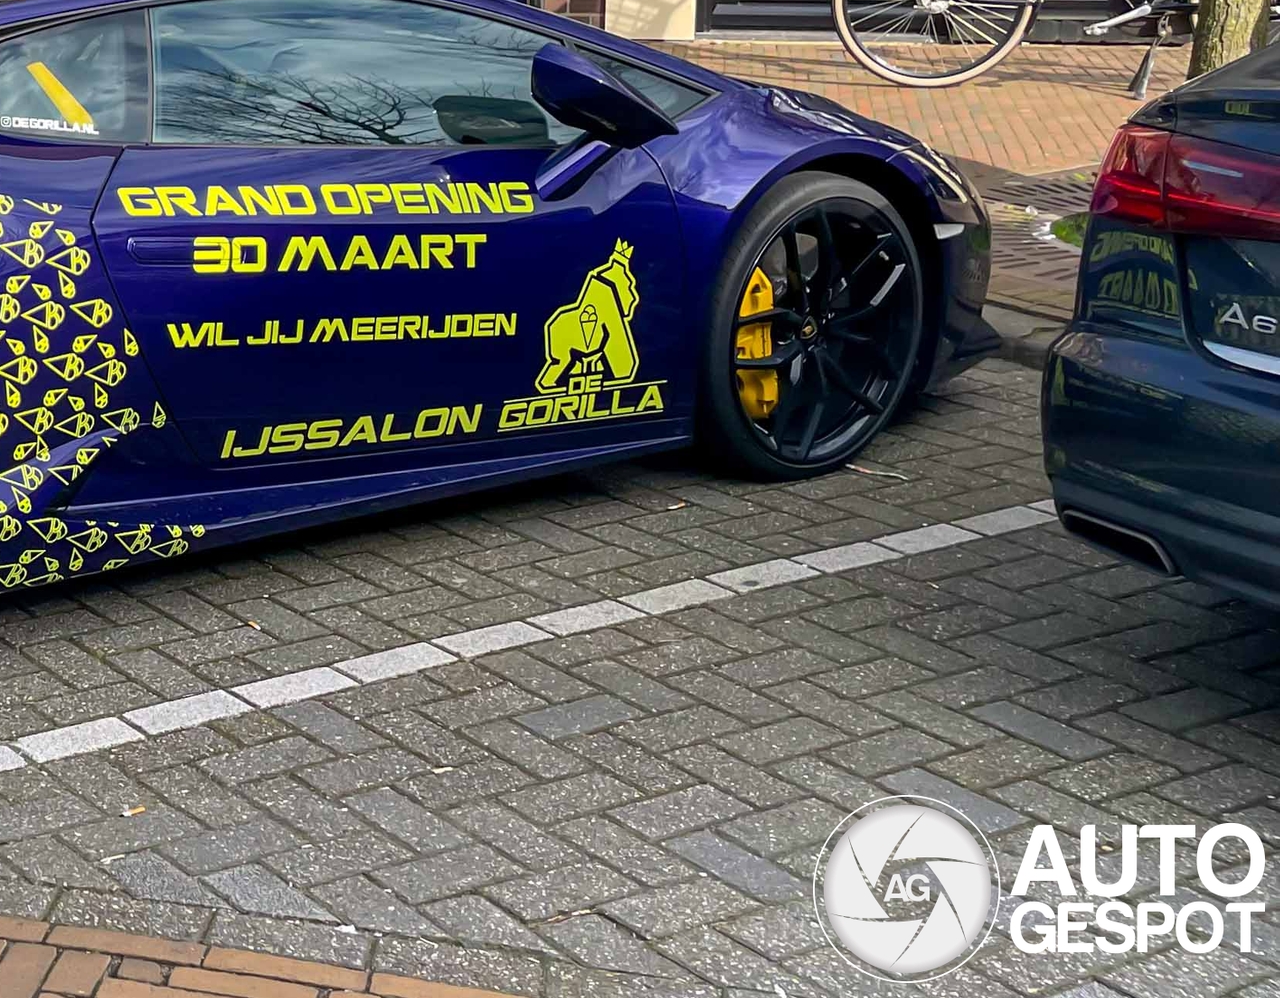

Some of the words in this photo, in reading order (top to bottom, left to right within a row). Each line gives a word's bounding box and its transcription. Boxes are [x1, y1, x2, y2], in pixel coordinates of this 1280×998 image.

[12, 116, 100, 135] DEGORILLA.NL
[116, 185, 317, 218] GRAND
[320, 181, 536, 215] OPENING
[192, 235, 267, 274] 30
[277, 233, 488, 273] MAART
[166, 322, 239, 349] WIL
[246, 319, 304, 346] JIJ
[308, 312, 518, 344] MEERIJDEN
[1220, 302, 1277, 334] A6
[566, 374, 603, 395] DE
[220, 403, 483, 459] IJSSALON
[498, 384, 665, 430] GORILLA
